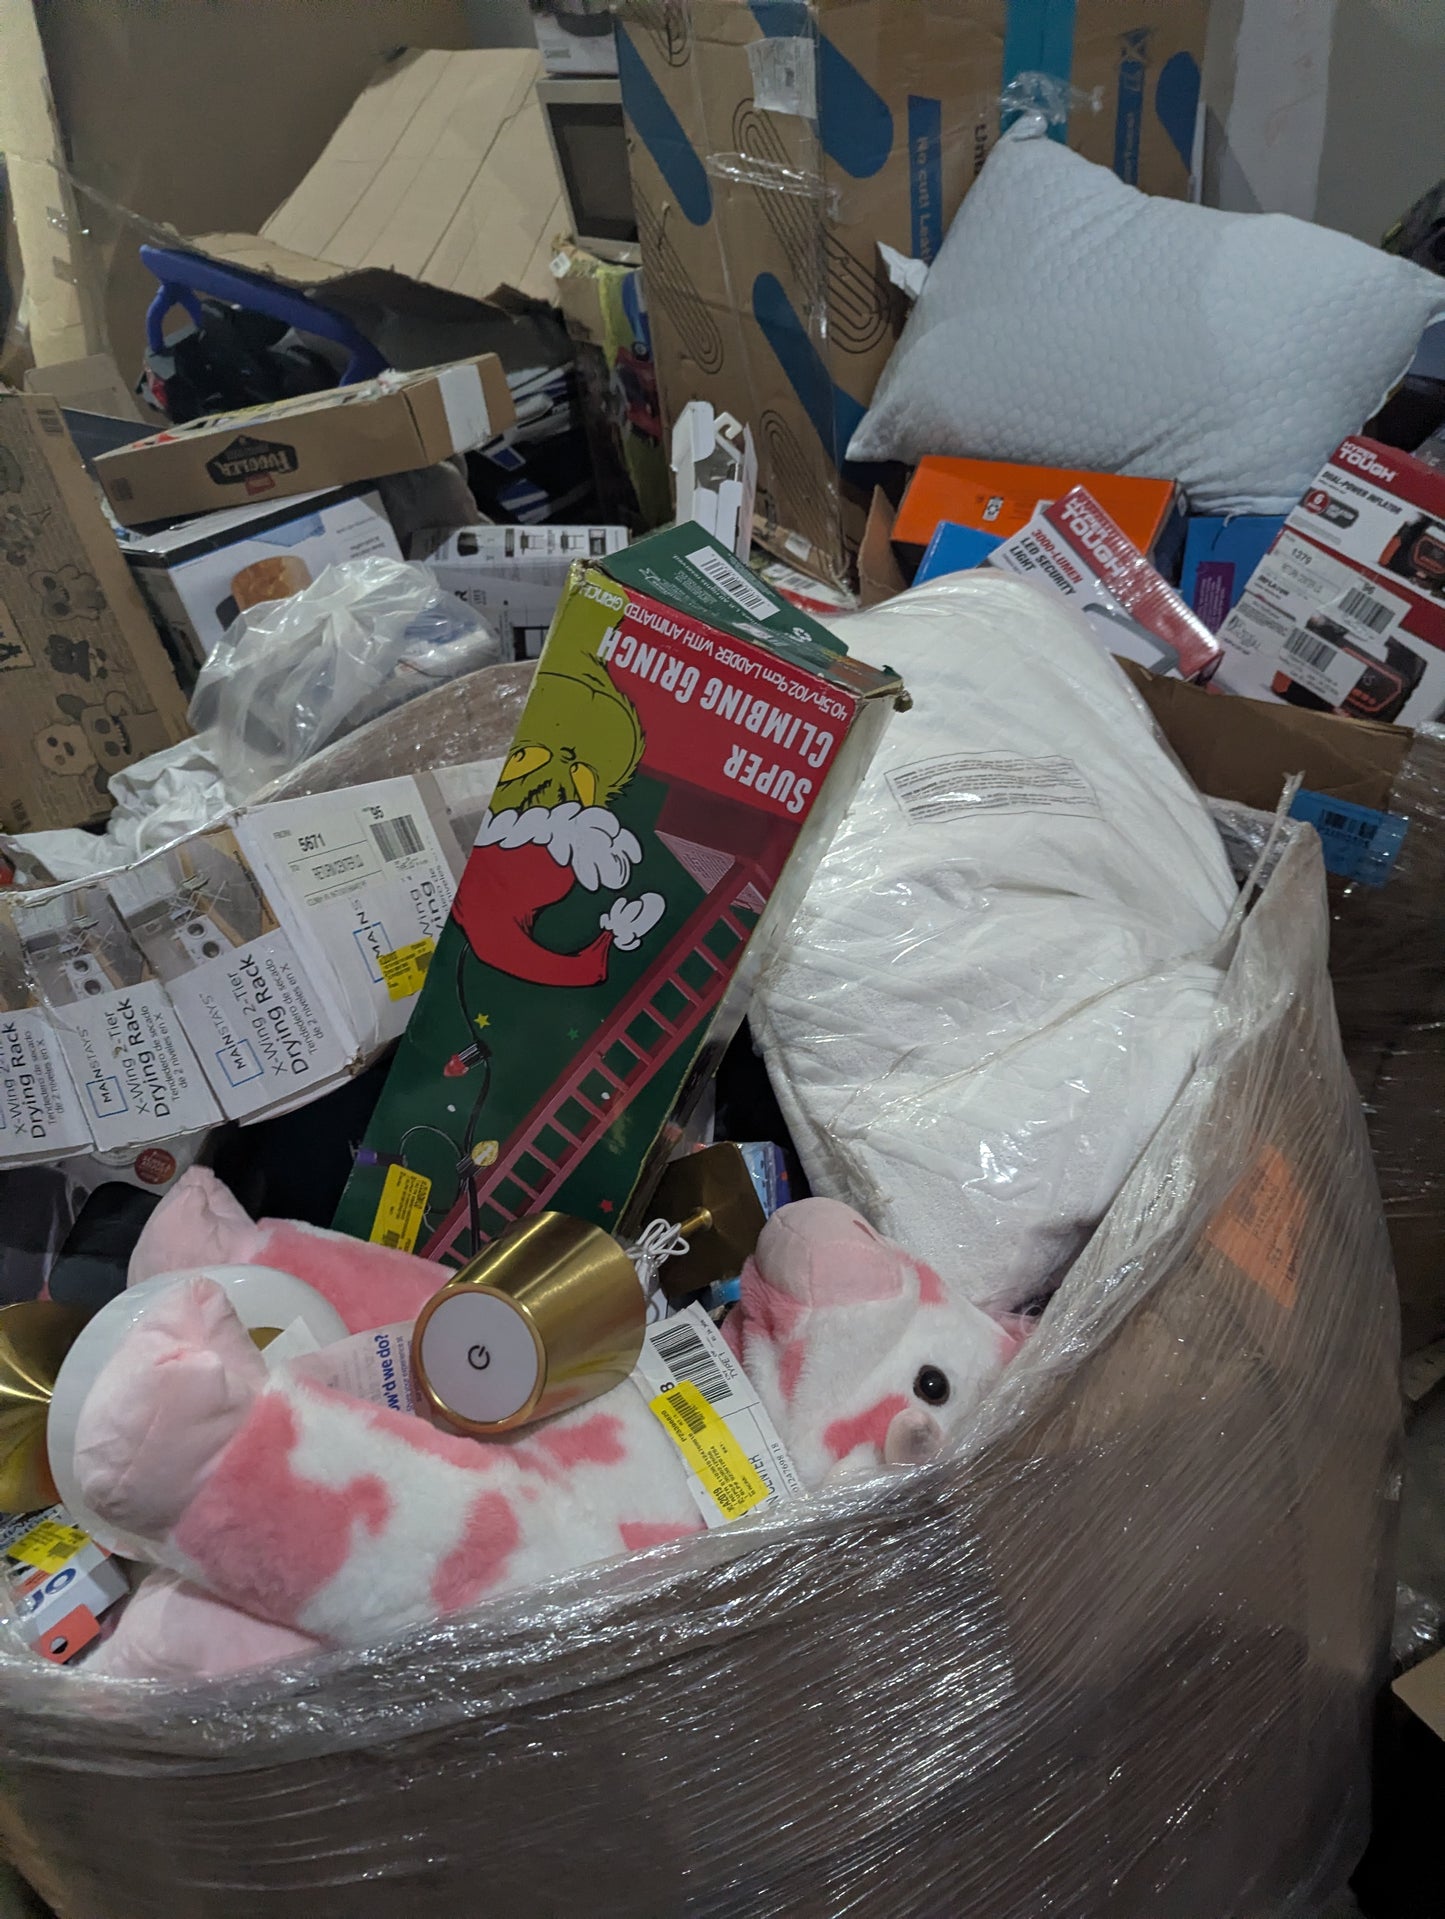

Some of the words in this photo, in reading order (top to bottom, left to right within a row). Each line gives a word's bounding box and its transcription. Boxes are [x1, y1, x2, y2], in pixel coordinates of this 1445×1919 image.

[1339, 447, 1397, 482] TOUGH
[1341, 441, 1378, 461] HYPER
[1064, 497, 1109, 540] HYPER
[1366, 491, 1403, 515] INFLATOR
[1008, 545, 1037, 572] LIGHT
[1031, 528, 1083, 585] 3000-LUMEN
[1061, 508, 1126, 577] TOUGH
[1020, 537, 1040, 556] LED
[1035, 554, 1077, 596] SECURITY
[579, 583, 624, 612] GRINCH
[624, 602, 684, 641] ANIMATED
[682, 631, 715, 656] WITH
[714, 645, 762, 680] LADDER
[596, 626, 700, 704] GRINCH
[700, 677, 834, 768] CLIMBING
[723, 744, 813, 814] SUPER
[239, 954, 273, 1004] Rack
[265, 958, 285, 992] secado
[279, 962, 290, 972] X
[286, 971, 299, 985] en
[227, 972, 256, 1016] 2-Tier
[283, 992, 293, 1005] de
[292, 984, 314, 1019] niveles
[117, 998, 146, 1047] Rack
[159, 1022, 169, 1035] en
[199, 993, 247, 1070] MAINSTAYS
[267, 1005, 309, 1075] Drying
[289, 1004, 318, 1055] Tendedero
[309, 1018, 319, 1027] 2
[313, 1026, 324, 1040] de
[1, 1022, 26, 1068] Rack
[77, 1026, 113, 1103] MAINSTAYS
[153, 1040, 163, 1052] de
[164, 1036, 180, 1067] niveles
[252, 1016, 288, 1076] X-Wing
[121, 1058, 151, 1116] X-Wing
[137, 1050, 171, 1118] Drying
[158, 1053, 181, 1101] Tendedero
[178, 1076, 188, 1089] de
[4, 1078, 28, 1135] X-Wing
[19, 1073, 46, 1138] Drying
[374, 1334, 391, 1358] do?
[382, 1359, 395, 1381] we
